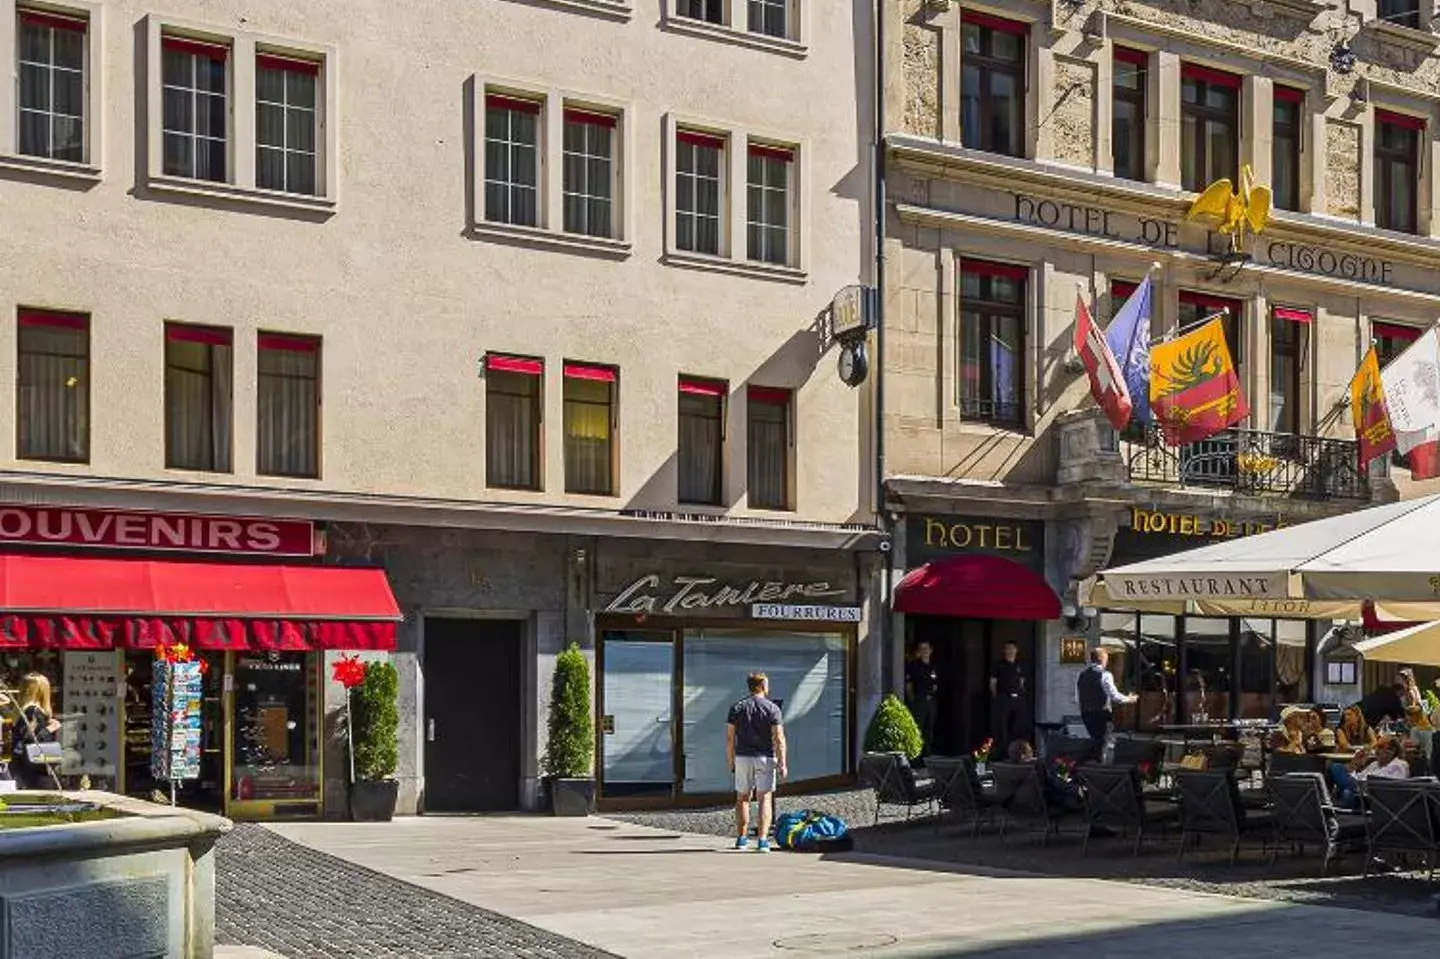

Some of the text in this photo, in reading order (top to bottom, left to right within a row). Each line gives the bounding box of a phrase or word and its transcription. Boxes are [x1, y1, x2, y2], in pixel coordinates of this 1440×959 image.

[1013, 194, 1120, 238] HOTEL
[1137, 216, 1179, 248] DE
[1267, 241, 1393, 284] CIGOGNE
[0, 509, 280, 550] OUVENIRS
[925, 517, 1032, 551] HOTEL
[1131, 505, 1203, 535] HOTEL
[1125, 577, 1270, 597] RESTAURANT
